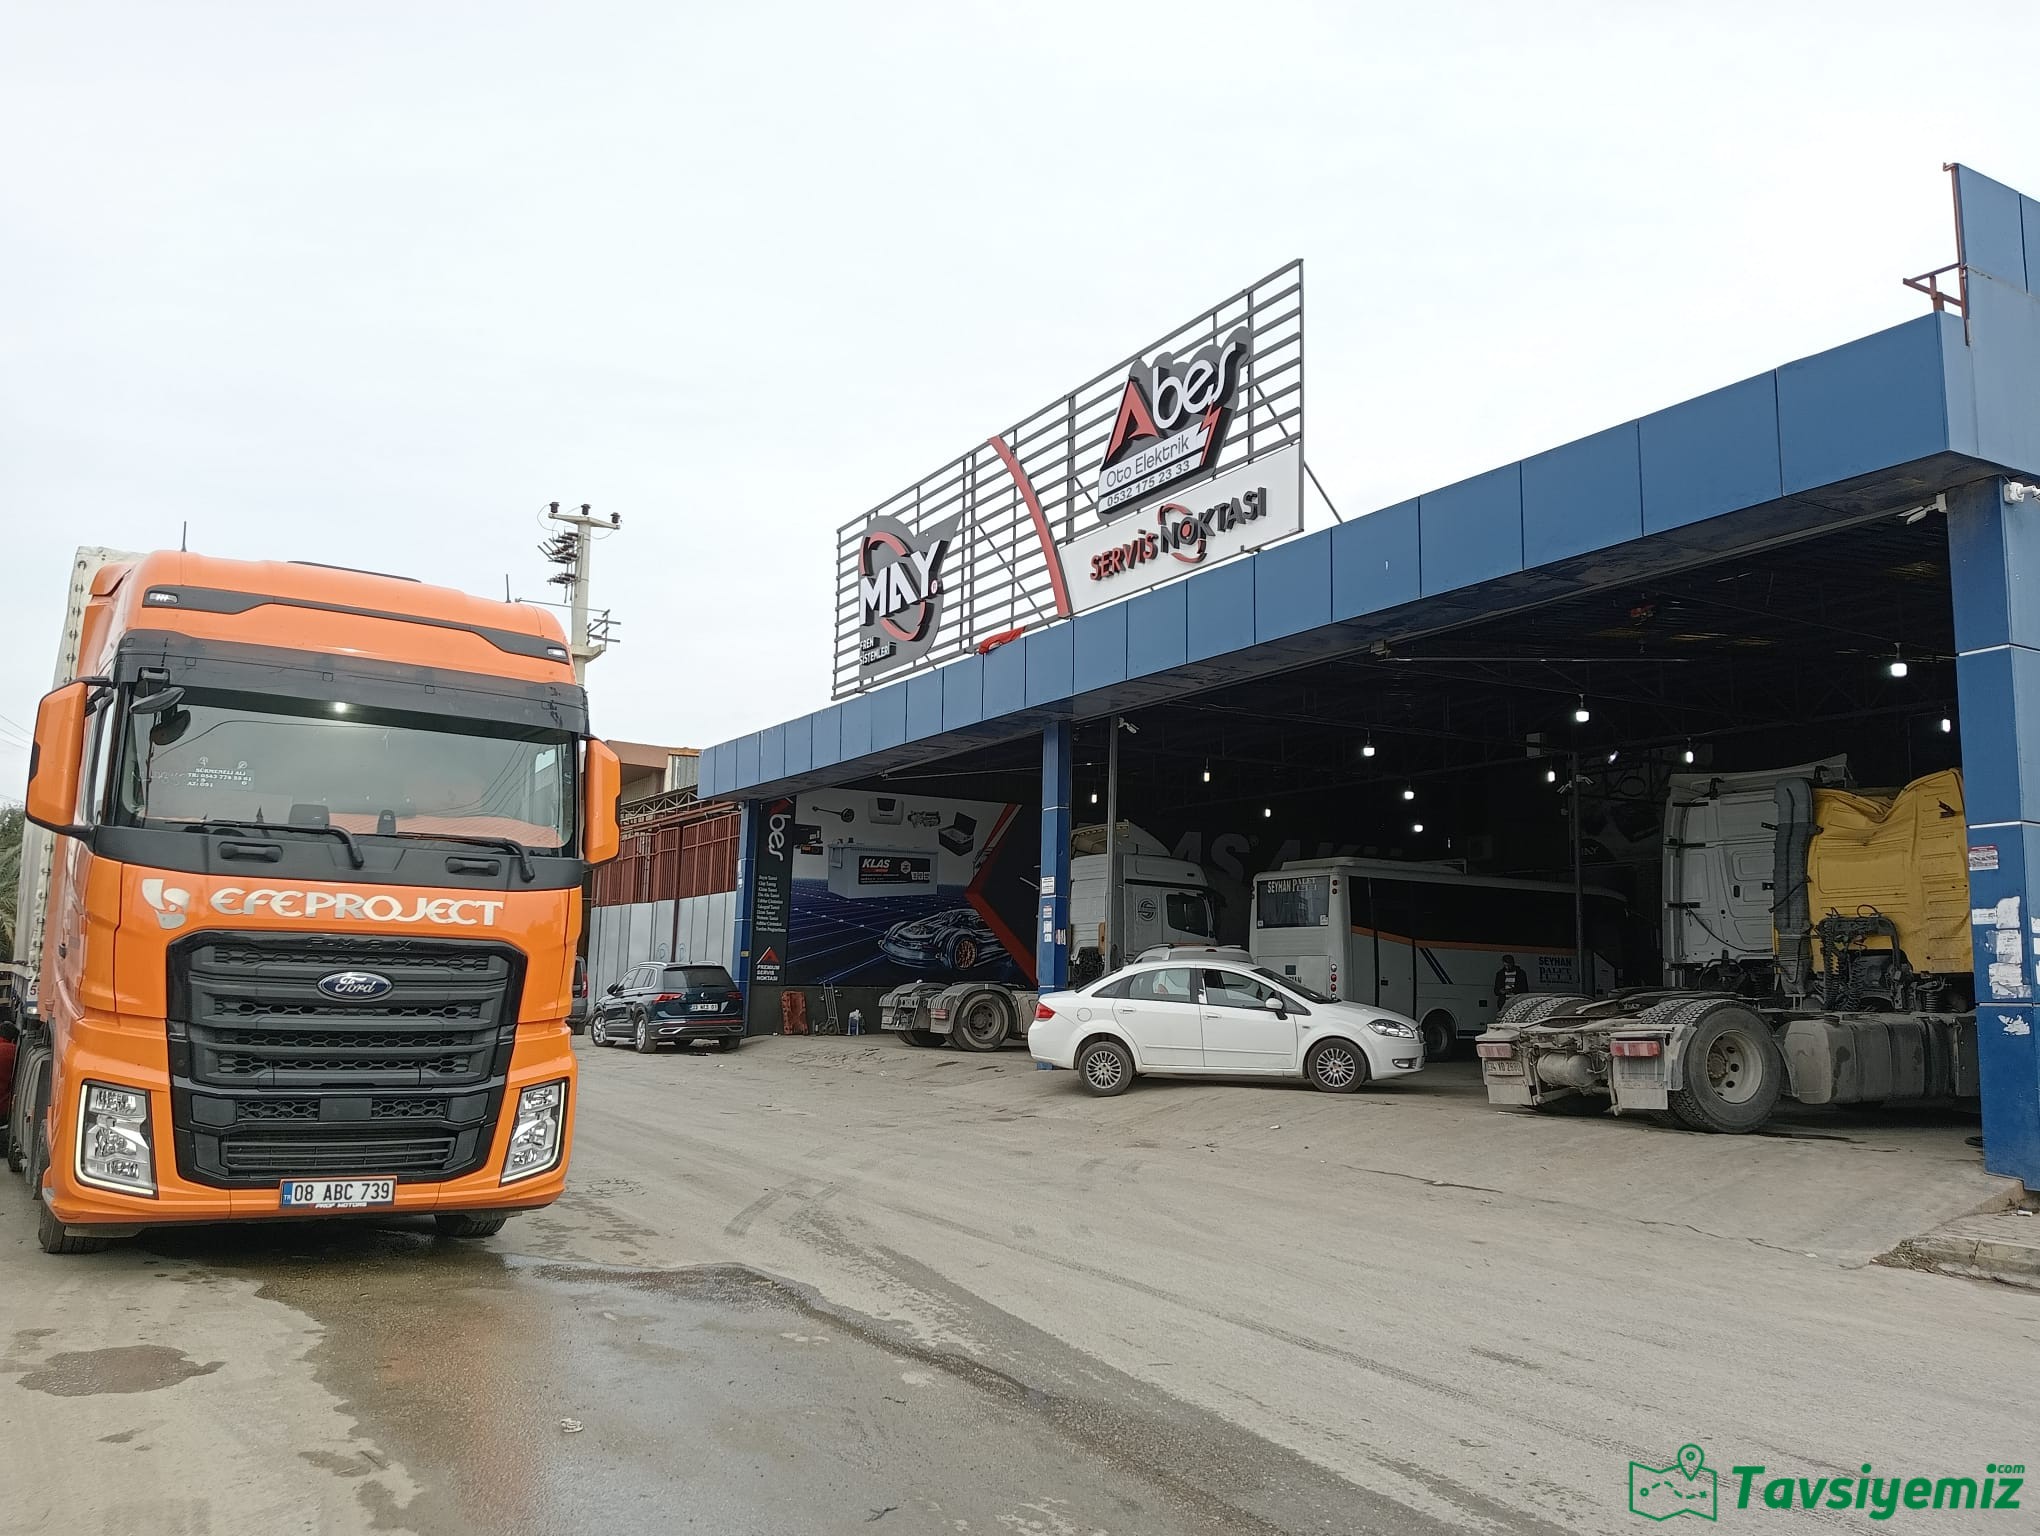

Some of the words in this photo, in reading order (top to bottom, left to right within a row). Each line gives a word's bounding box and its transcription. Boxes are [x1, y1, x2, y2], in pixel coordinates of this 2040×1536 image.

[1105, 341, 1240, 464] Abes
[1106, 467, 1132, 488] Oto
[1135, 434, 1190, 476] Elektrik
[1106, 486, 1133, 507] 0532
[1135, 476, 1156, 495] 175
[1158, 468, 1172, 484] 23
[1175, 460, 1190, 476] 33
[1089, 529, 1159, 581] SERVİS
[1160, 486, 1268, 554] NOKTASI
[859, 540, 947, 626] MAY
[862, 858, 891, 868] KLAS
[1267, 879, 1291, 894] SEYHAN
[209, 887, 504, 926] EFEPROJECT
[1538, 955, 1572, 967] SEYHAN
[335, 972, 377, 993] Ford
[294, 1184, 314, 1202] 08
[323, 1183, 353, 1201] ABC
[360, 1182, 390, 1199] 739
